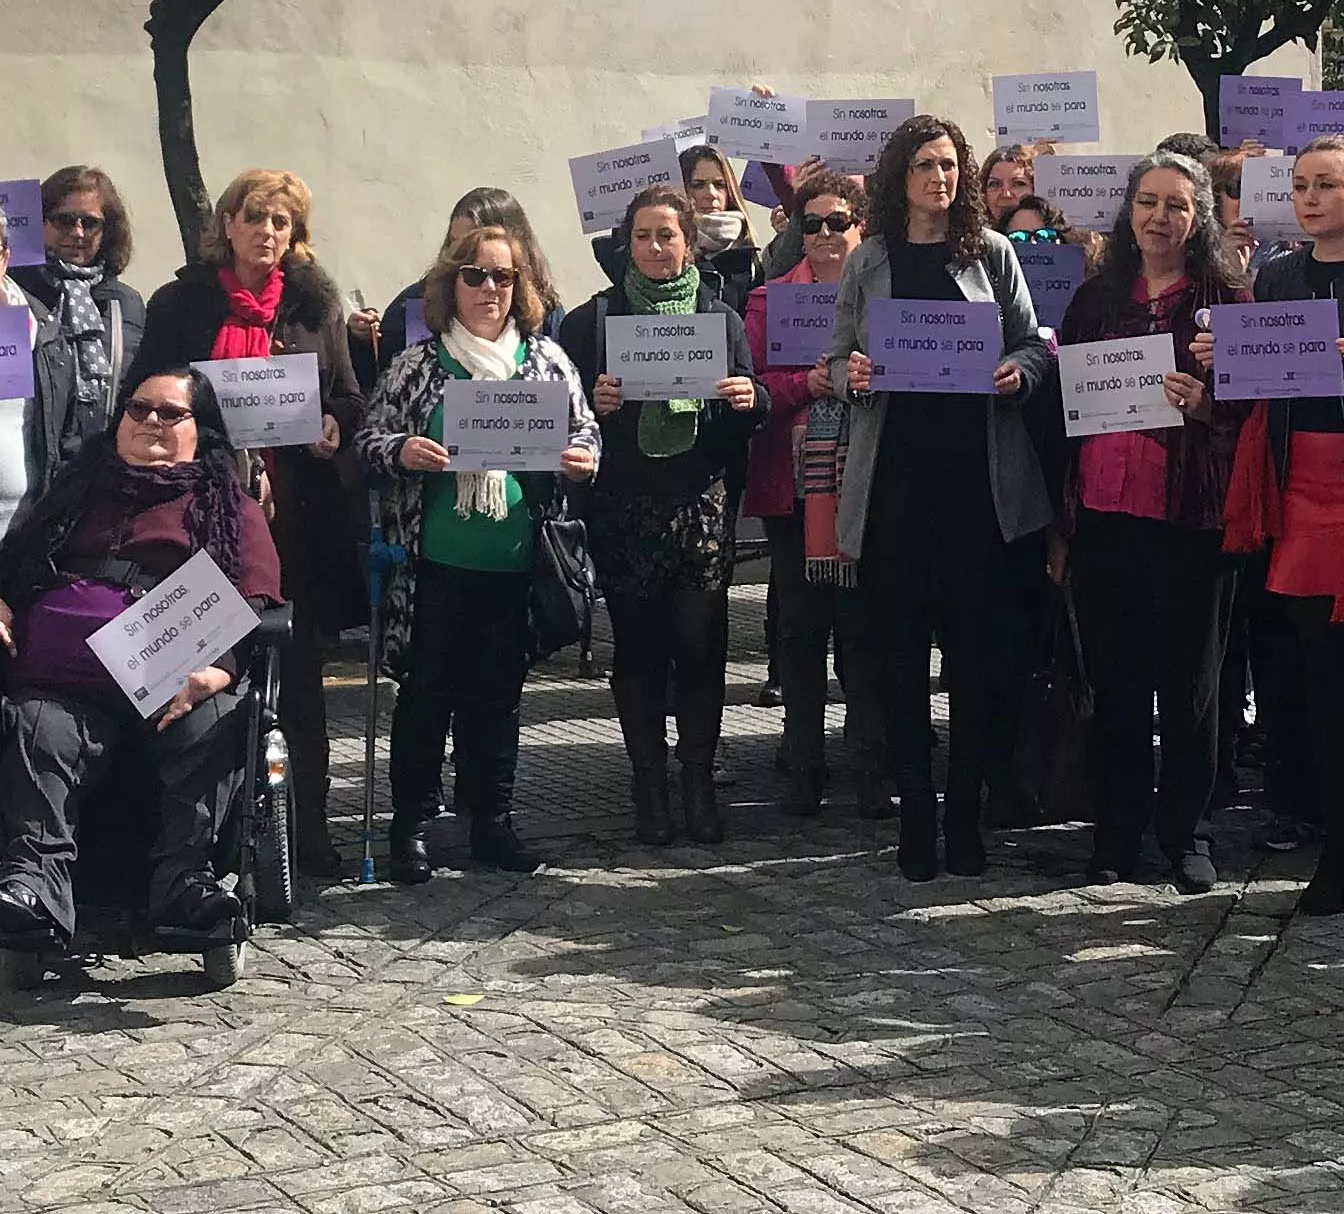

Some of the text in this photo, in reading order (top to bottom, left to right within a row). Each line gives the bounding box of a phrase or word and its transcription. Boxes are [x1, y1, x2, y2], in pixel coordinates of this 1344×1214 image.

[900, 309, 917, 324] Sin
[1240, 314, 1257, 329] Sin
[634, 324, 650, 338] Sin
[897, 336, 938, 350] mundo
[956, 339, 985, 354] para
[1226, 340, 1327, 357] el mundo se para
[619, 348, 714, 364] el mundo se para
[1085, 352, 1101, 367] Sin
[221, 369, 239, 384] Sin
[1074, 374, 1164, 395] el mundo se para
[263, 394, 276, 406] se
[279, 391, 306, 407] para
[474, 390, 491, 405] Sin
[471, 415, 511, 430] mundo
[527, 418, 555, 433] para
[123, 620, 145, 637] Sin
[127, 592, 221, 671] el mundo se para
